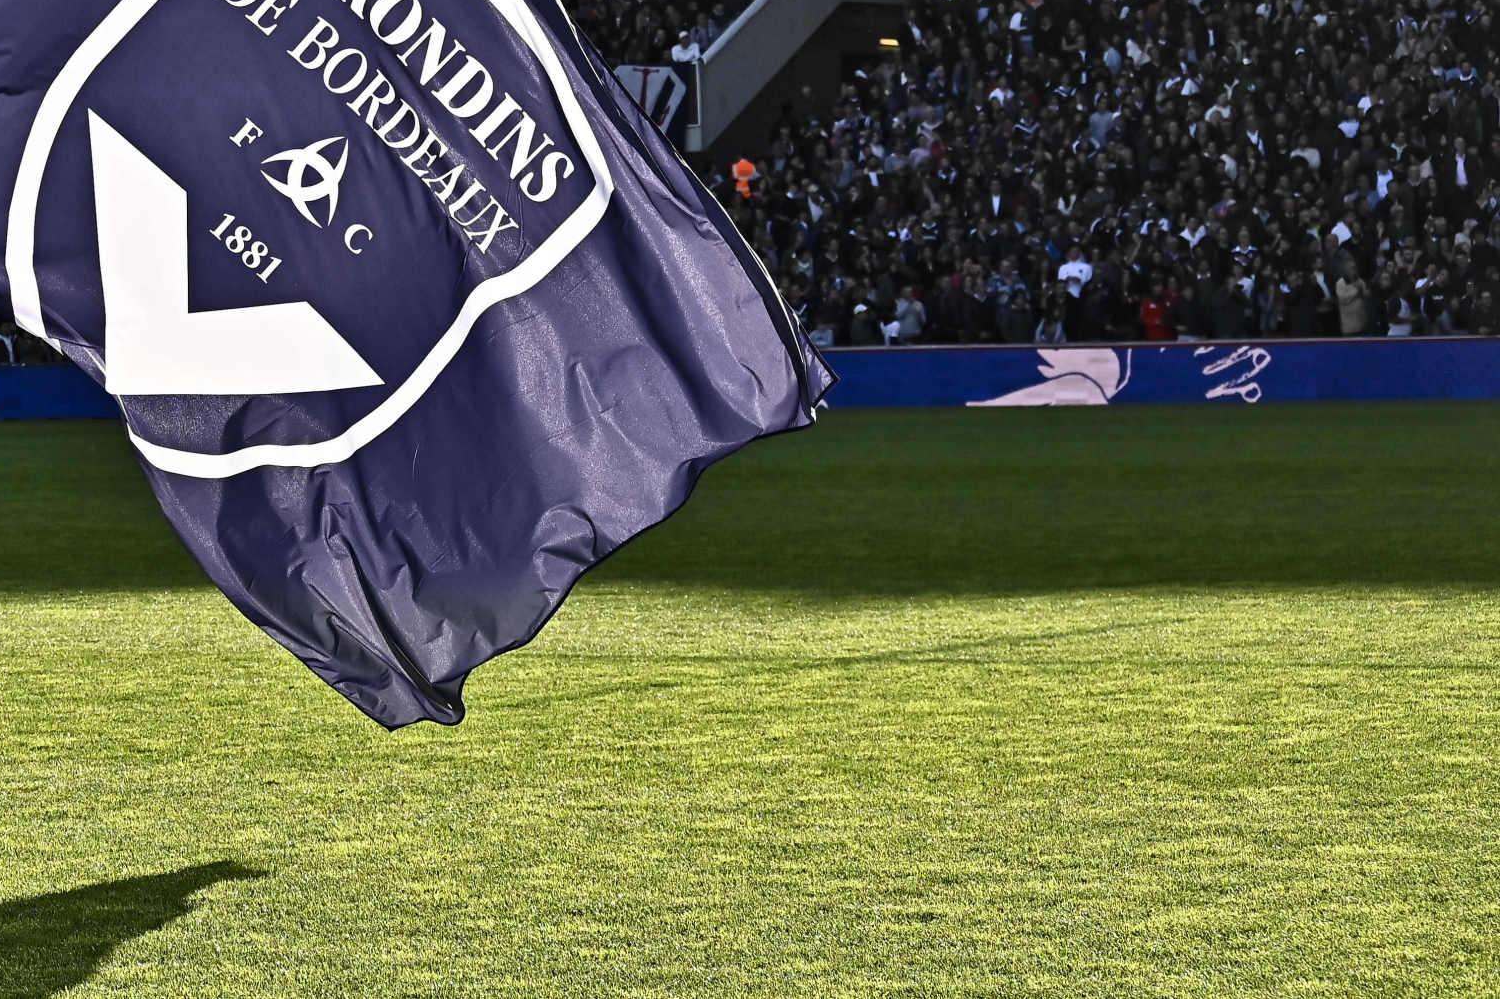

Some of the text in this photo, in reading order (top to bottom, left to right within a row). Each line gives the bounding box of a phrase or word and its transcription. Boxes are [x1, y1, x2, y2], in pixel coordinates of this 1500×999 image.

[229, 117, 264, 147] F
[287, 16, 519, 254] BORDEAUX
[209, 213, 282, 284] 1881
[344, 223, 373, 255] C
